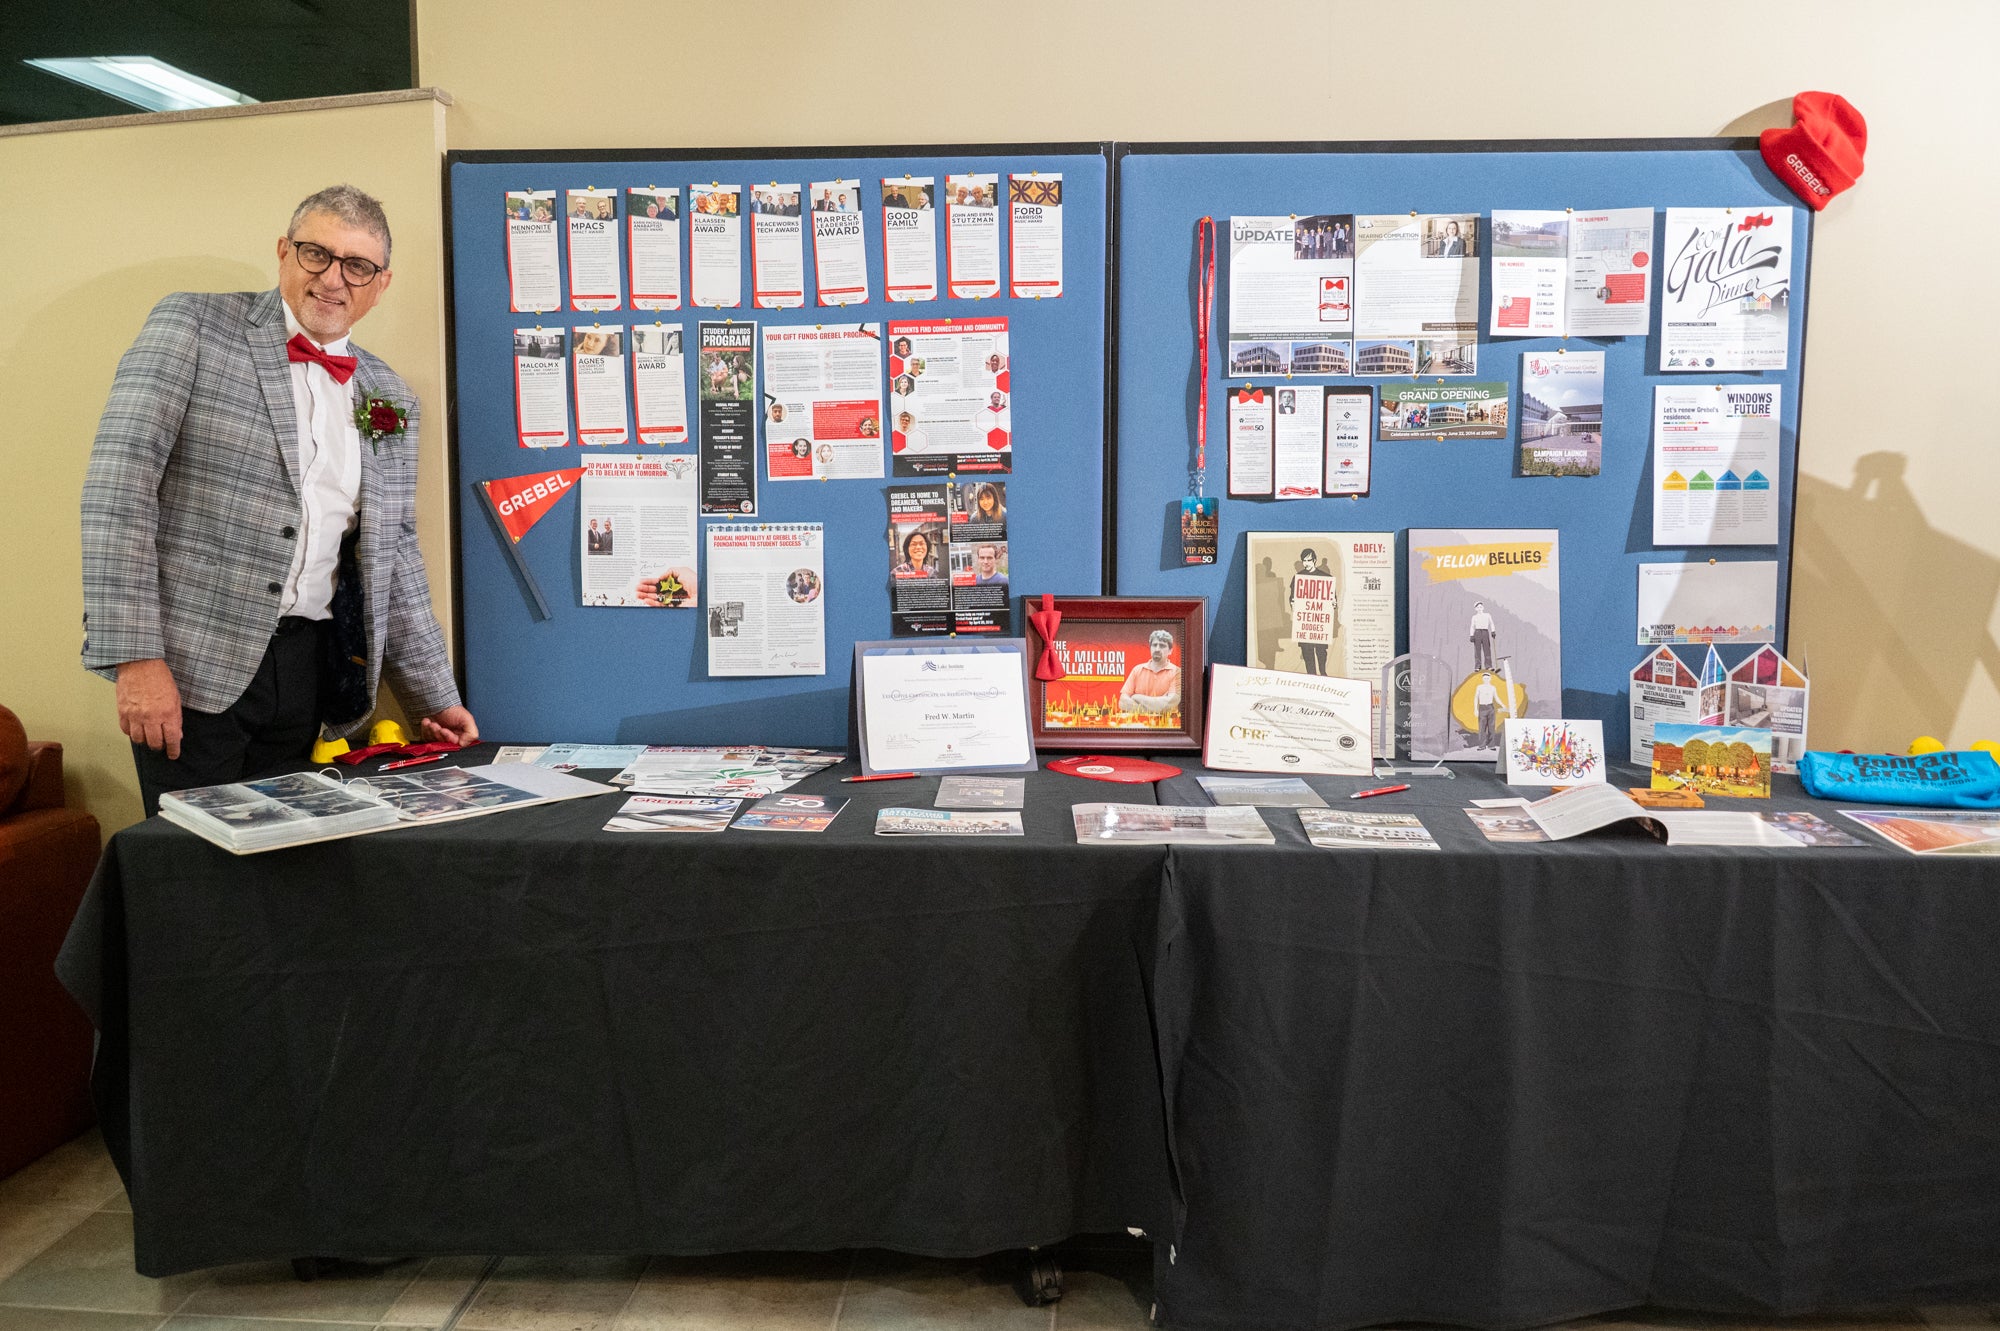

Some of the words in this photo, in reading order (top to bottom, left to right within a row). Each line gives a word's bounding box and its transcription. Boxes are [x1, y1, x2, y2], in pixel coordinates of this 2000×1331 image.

[1786, 154, 1822, 195] GREBEL
[816, 214, 859, 223] MARPECK
[887, 219, 918, 227] FAMILY
[816, 221, 859, 229] LEADERSHIP
[817, 227, 860, 237] AWARD
[1234, 230, 1294, 241] UPDATE
[1667, 222, 1782, 303] Gala
[975, 323, 1005, 331] COMMUNITY
[703, 335, 750, 346] PROGRAM
[1399, 391, 1438, 400] GRAND
[1441, 391, 1490, 399] OPENING
[1727, 393, 1772, 403] WINDOWS
[1734, 404, 1771, 414] FUTURE
[499, 473, 571, 516] GREBEL
[1198, 546, 1216, 554] PASS
[1353, 543, 1385, 553] GADFLY:
[1436, 553, 1488, 568] YELLOW
[1296, 579, 1333, 601] GADFLY:
[1305, 601, 1323, 611] SAM
[1296, 612, 1330, 623] STEINER
[1301, 623, 1324, 631] DODGES
[1296, 632, 1307, 640] THE
[1056, 650, 1070, 663] IX
[1074, 651, 1125, 663] MILLION
[1062, 663, 1092, 675] OLLAR
[1096, 663, 1125, 675] MAN
[1276, 677, 1350, 698] International
[1643, 690, 1668, 698] SUSTAINABLE
[1250, 702, 1278, 712] Fred
[1281, 704, 1293, 713] W.
[1295, 707, 1335, 718] Martin
[1853, 752, 1958, 769] Conrad
[1859, 765, 1969, 781] Grebel
[776, 797, 825, 808] 50
